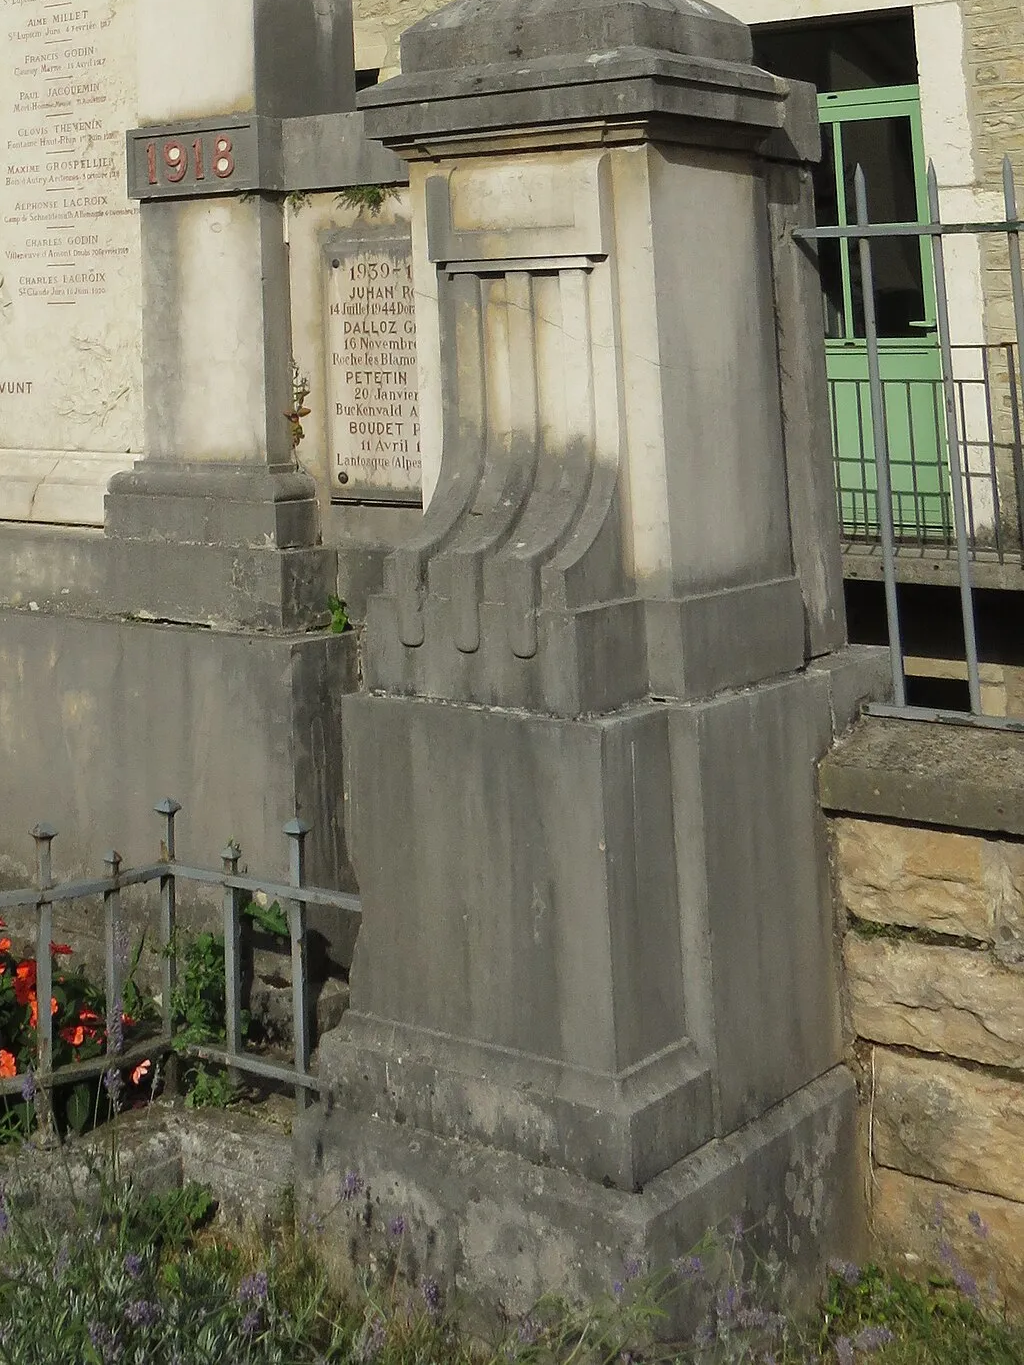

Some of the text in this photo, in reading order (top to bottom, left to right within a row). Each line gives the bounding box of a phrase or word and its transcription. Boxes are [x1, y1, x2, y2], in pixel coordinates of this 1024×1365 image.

[53, 10, 88, 23] MILLET
[25, 47, 94, 64] FRANCIS GODIN
[20, 83, 100, 100] PAUL JACQUEMIN
[18, 127, 48, 137] CLOVIS
[146, 134, 234, 185] 1918
[8, 165, 40, 174] MAXIME
[15, 196, 108, 210] ALPHONSE LACROIX
[26, 235, 99, 247] CHARLES GODIN
[19, 273, 106, 285] CHARLES LACROIX
[349, 286, 393, 300] JUHAN
[330, 304, 340, 315] 14
[371, 302, 396, 315] 1944
[344, 321, 397, 336] DALLOZ
[344, 337, 356, 350] 16
[333, 352, 362, 365] Roche
[346, 371, 407, 385] PETETIN
[355, 388, 368, 400] 20
[350, 422, 404, 435] BOUDET
[361, 440, 370, 450] 11
[376, 439, 408, 452] Avril
[337, 453, 389, 470] Lantosque
